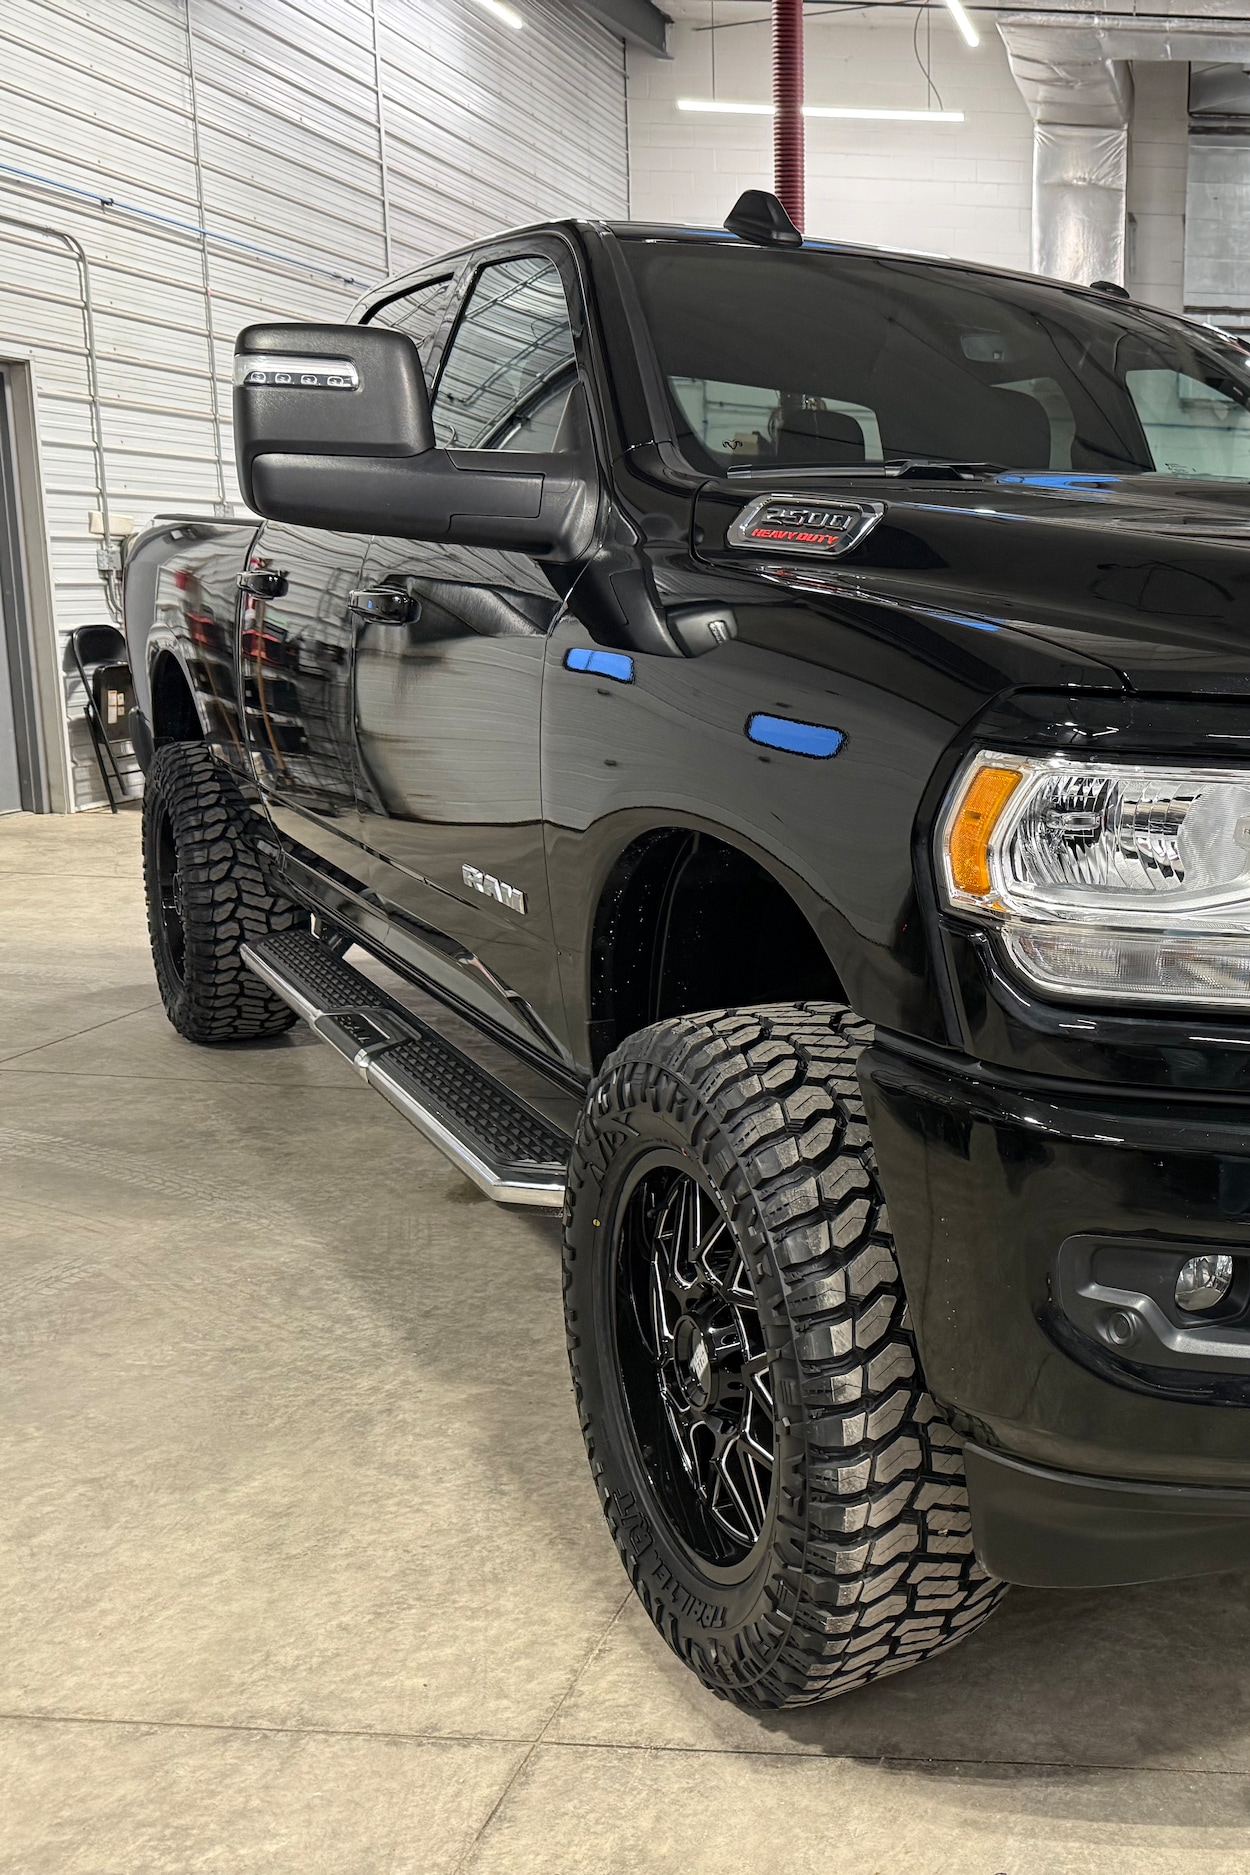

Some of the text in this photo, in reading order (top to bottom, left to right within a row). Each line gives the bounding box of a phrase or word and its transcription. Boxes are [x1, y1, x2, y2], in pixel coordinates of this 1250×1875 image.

[761, 507, 853, 531] 2500
[751, 528, 839, 545] HEAVY DUTY
[462, 863, 527, 915] RAM
